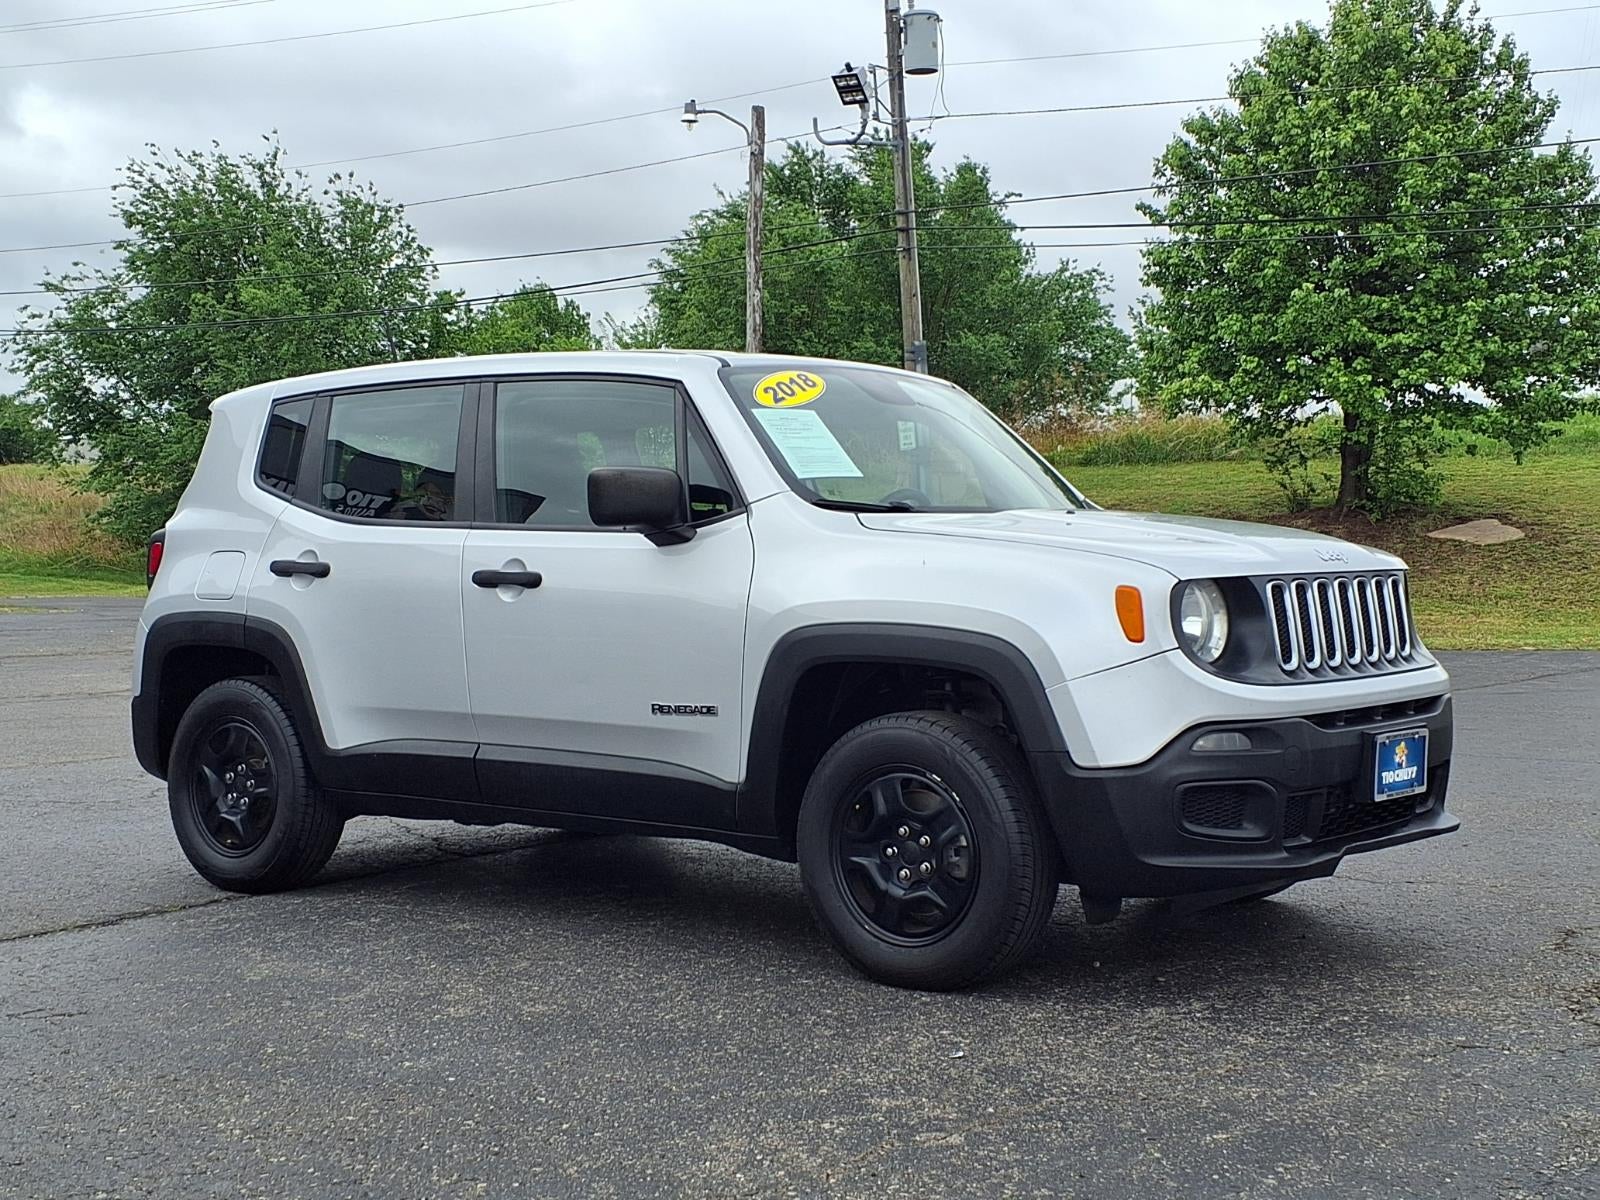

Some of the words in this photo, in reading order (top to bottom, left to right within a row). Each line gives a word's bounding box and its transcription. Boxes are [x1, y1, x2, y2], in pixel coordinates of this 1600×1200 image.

[763, 374, 817, 404] 2018
[1313, 547, 1349, 565] Jeep
[1382, 771, 1394, 784] TIO
